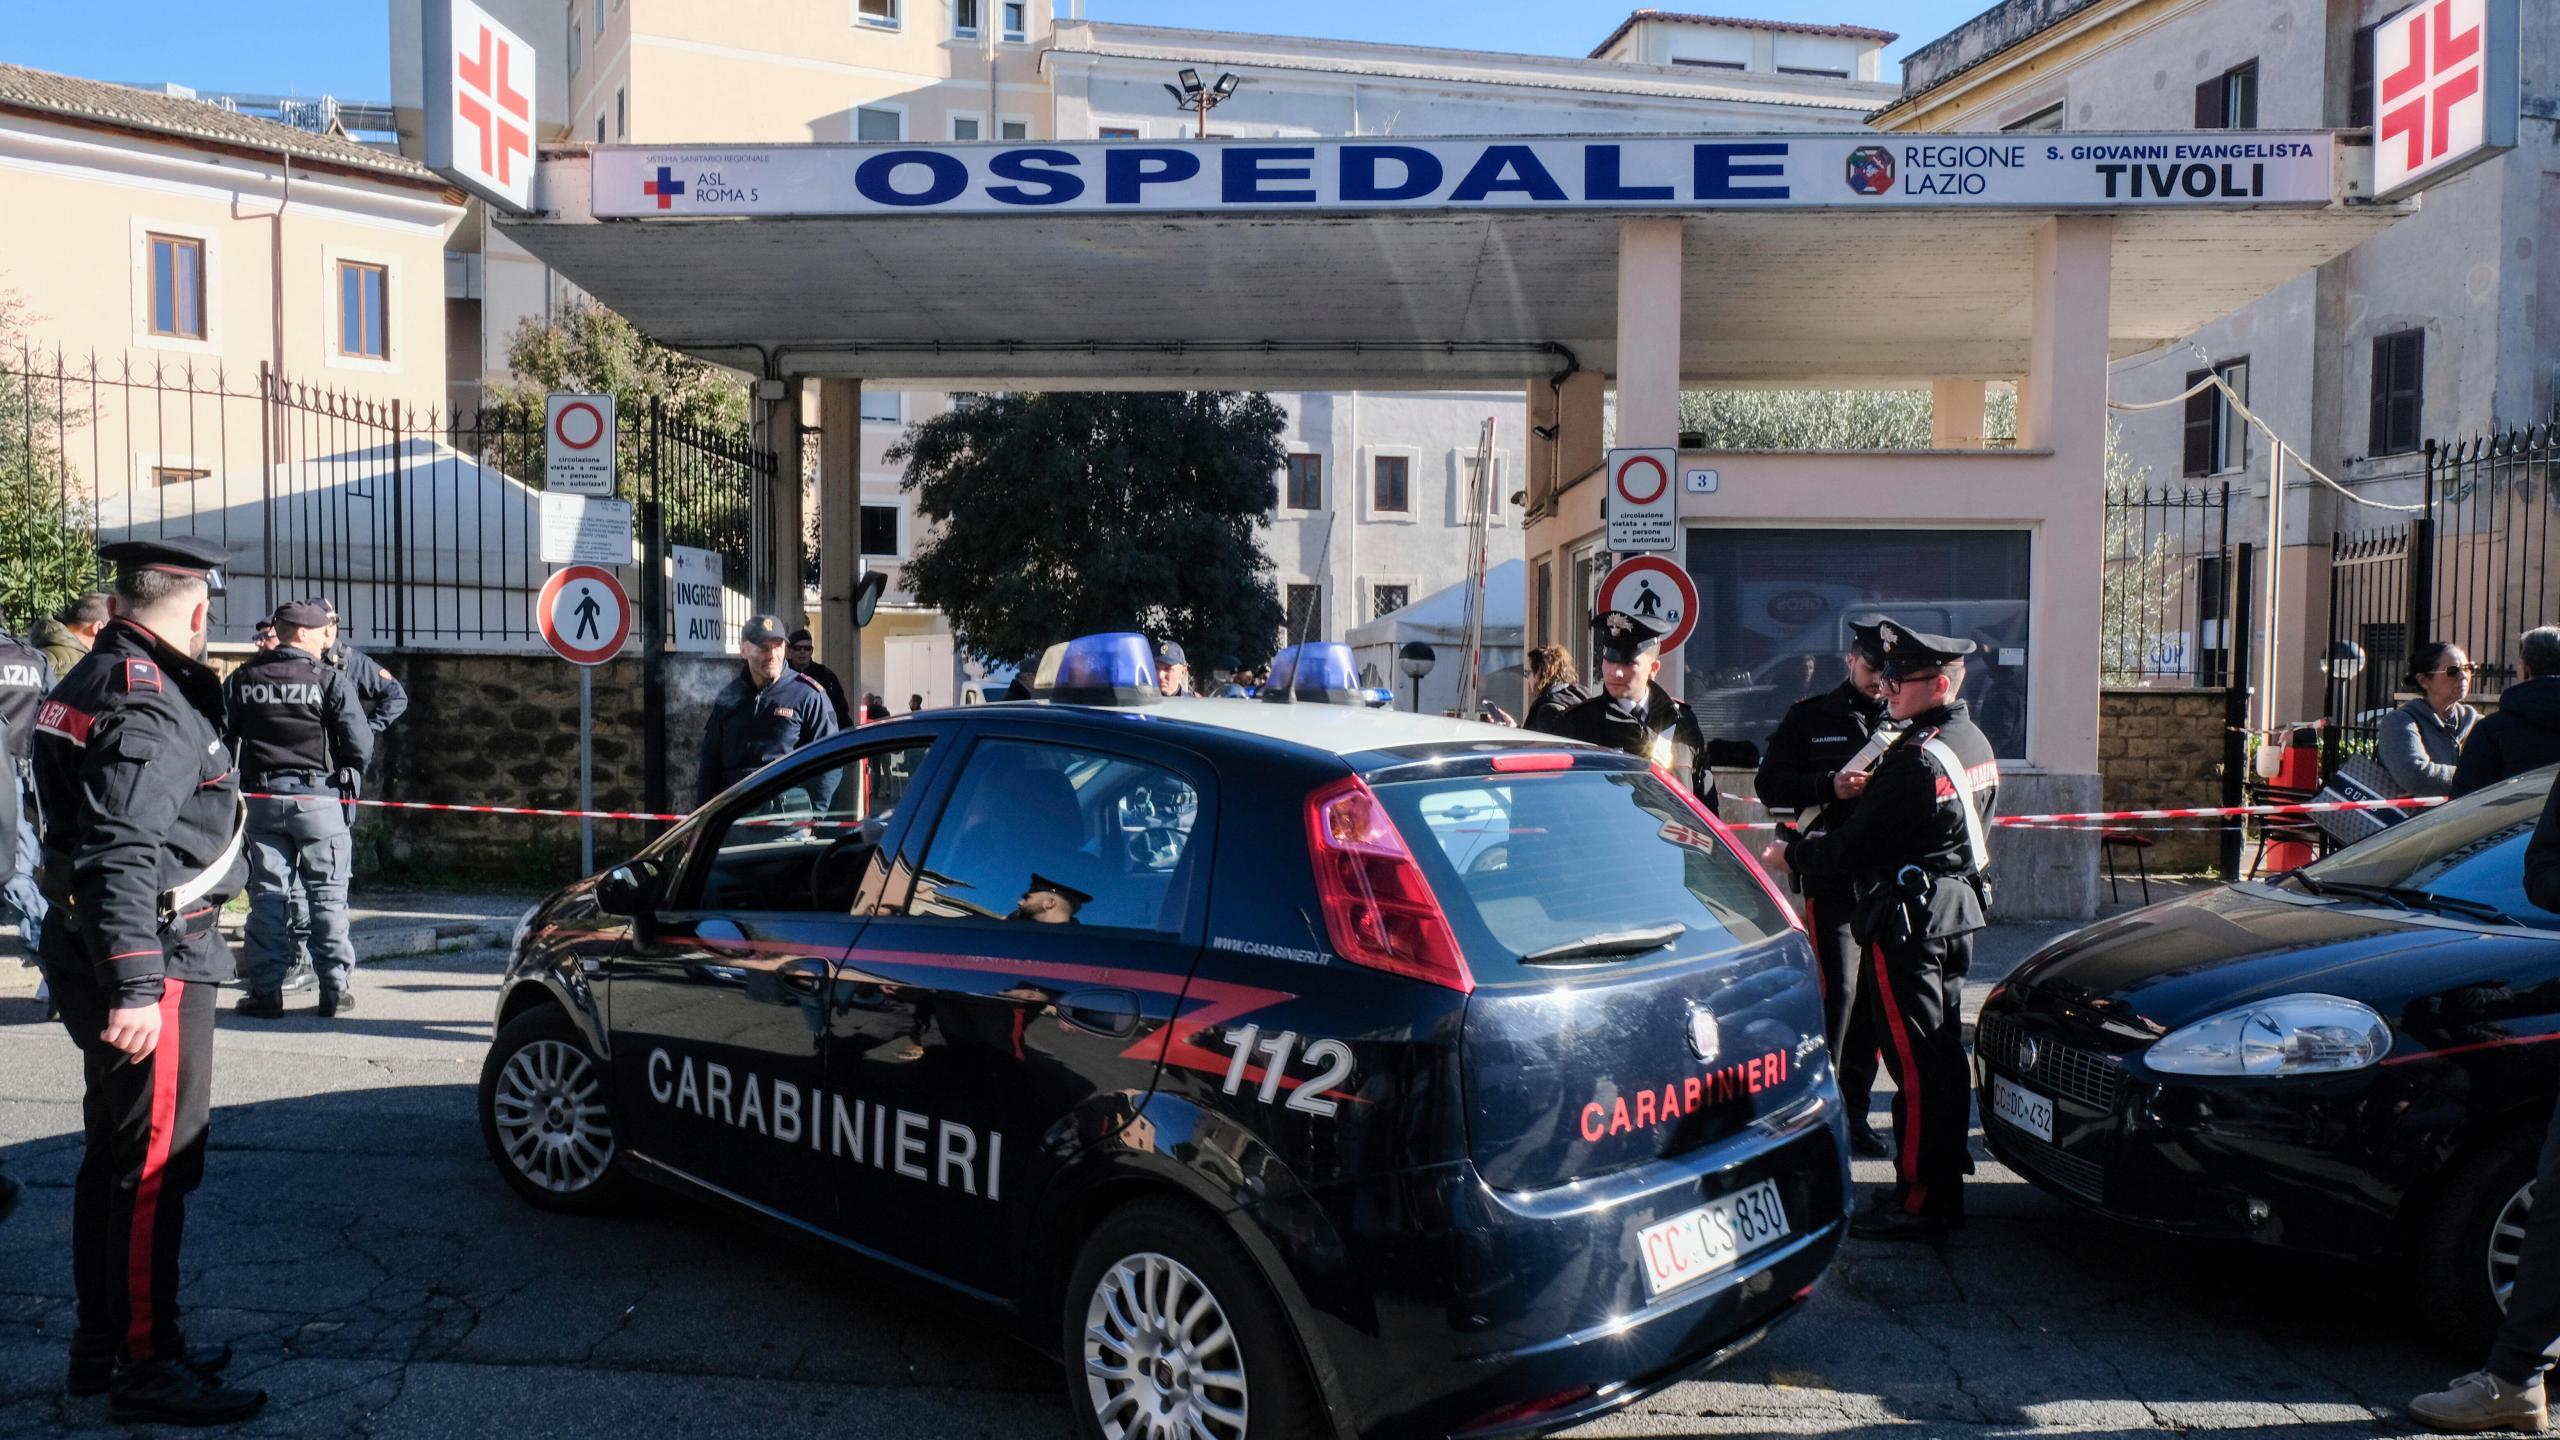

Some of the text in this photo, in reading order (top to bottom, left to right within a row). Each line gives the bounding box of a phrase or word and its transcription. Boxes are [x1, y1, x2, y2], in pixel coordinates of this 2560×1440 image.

[646, 154, 769, 163] SISTEMA SANITARIO REGIONALE
[1905, 146, 2025, 168] REGIONE
[2046, 143, 2313, 160] S. GIOVANNI EVANGELISTA
[697, 172, 726, 186] ASL
[855, 143, 1790, 206] OSPEDALE
[1905, 173, 1986, 195] LAZIO
[2095, 163, 2264, 198] TIVOLI
[696, 188, 758, 202] ROMA 5
[1698, 475, 1707, 487] 3
[688, 617, 721, 641] AUTO
[240, 683, 323, 704] POLIZIA
[1213, 935, 1332, 966] WWW.CARABINIERI.IT
[1222, 1022, 1354, 1119] 112
[1580, 1049, 1788, 1142] CARABINIERI
[647, 1047, 1002, 1201] CARABINIERI
[2029, 1103, 2051, 1133] 432
[1647, 1185, 1782, 1280] CC CS 830
